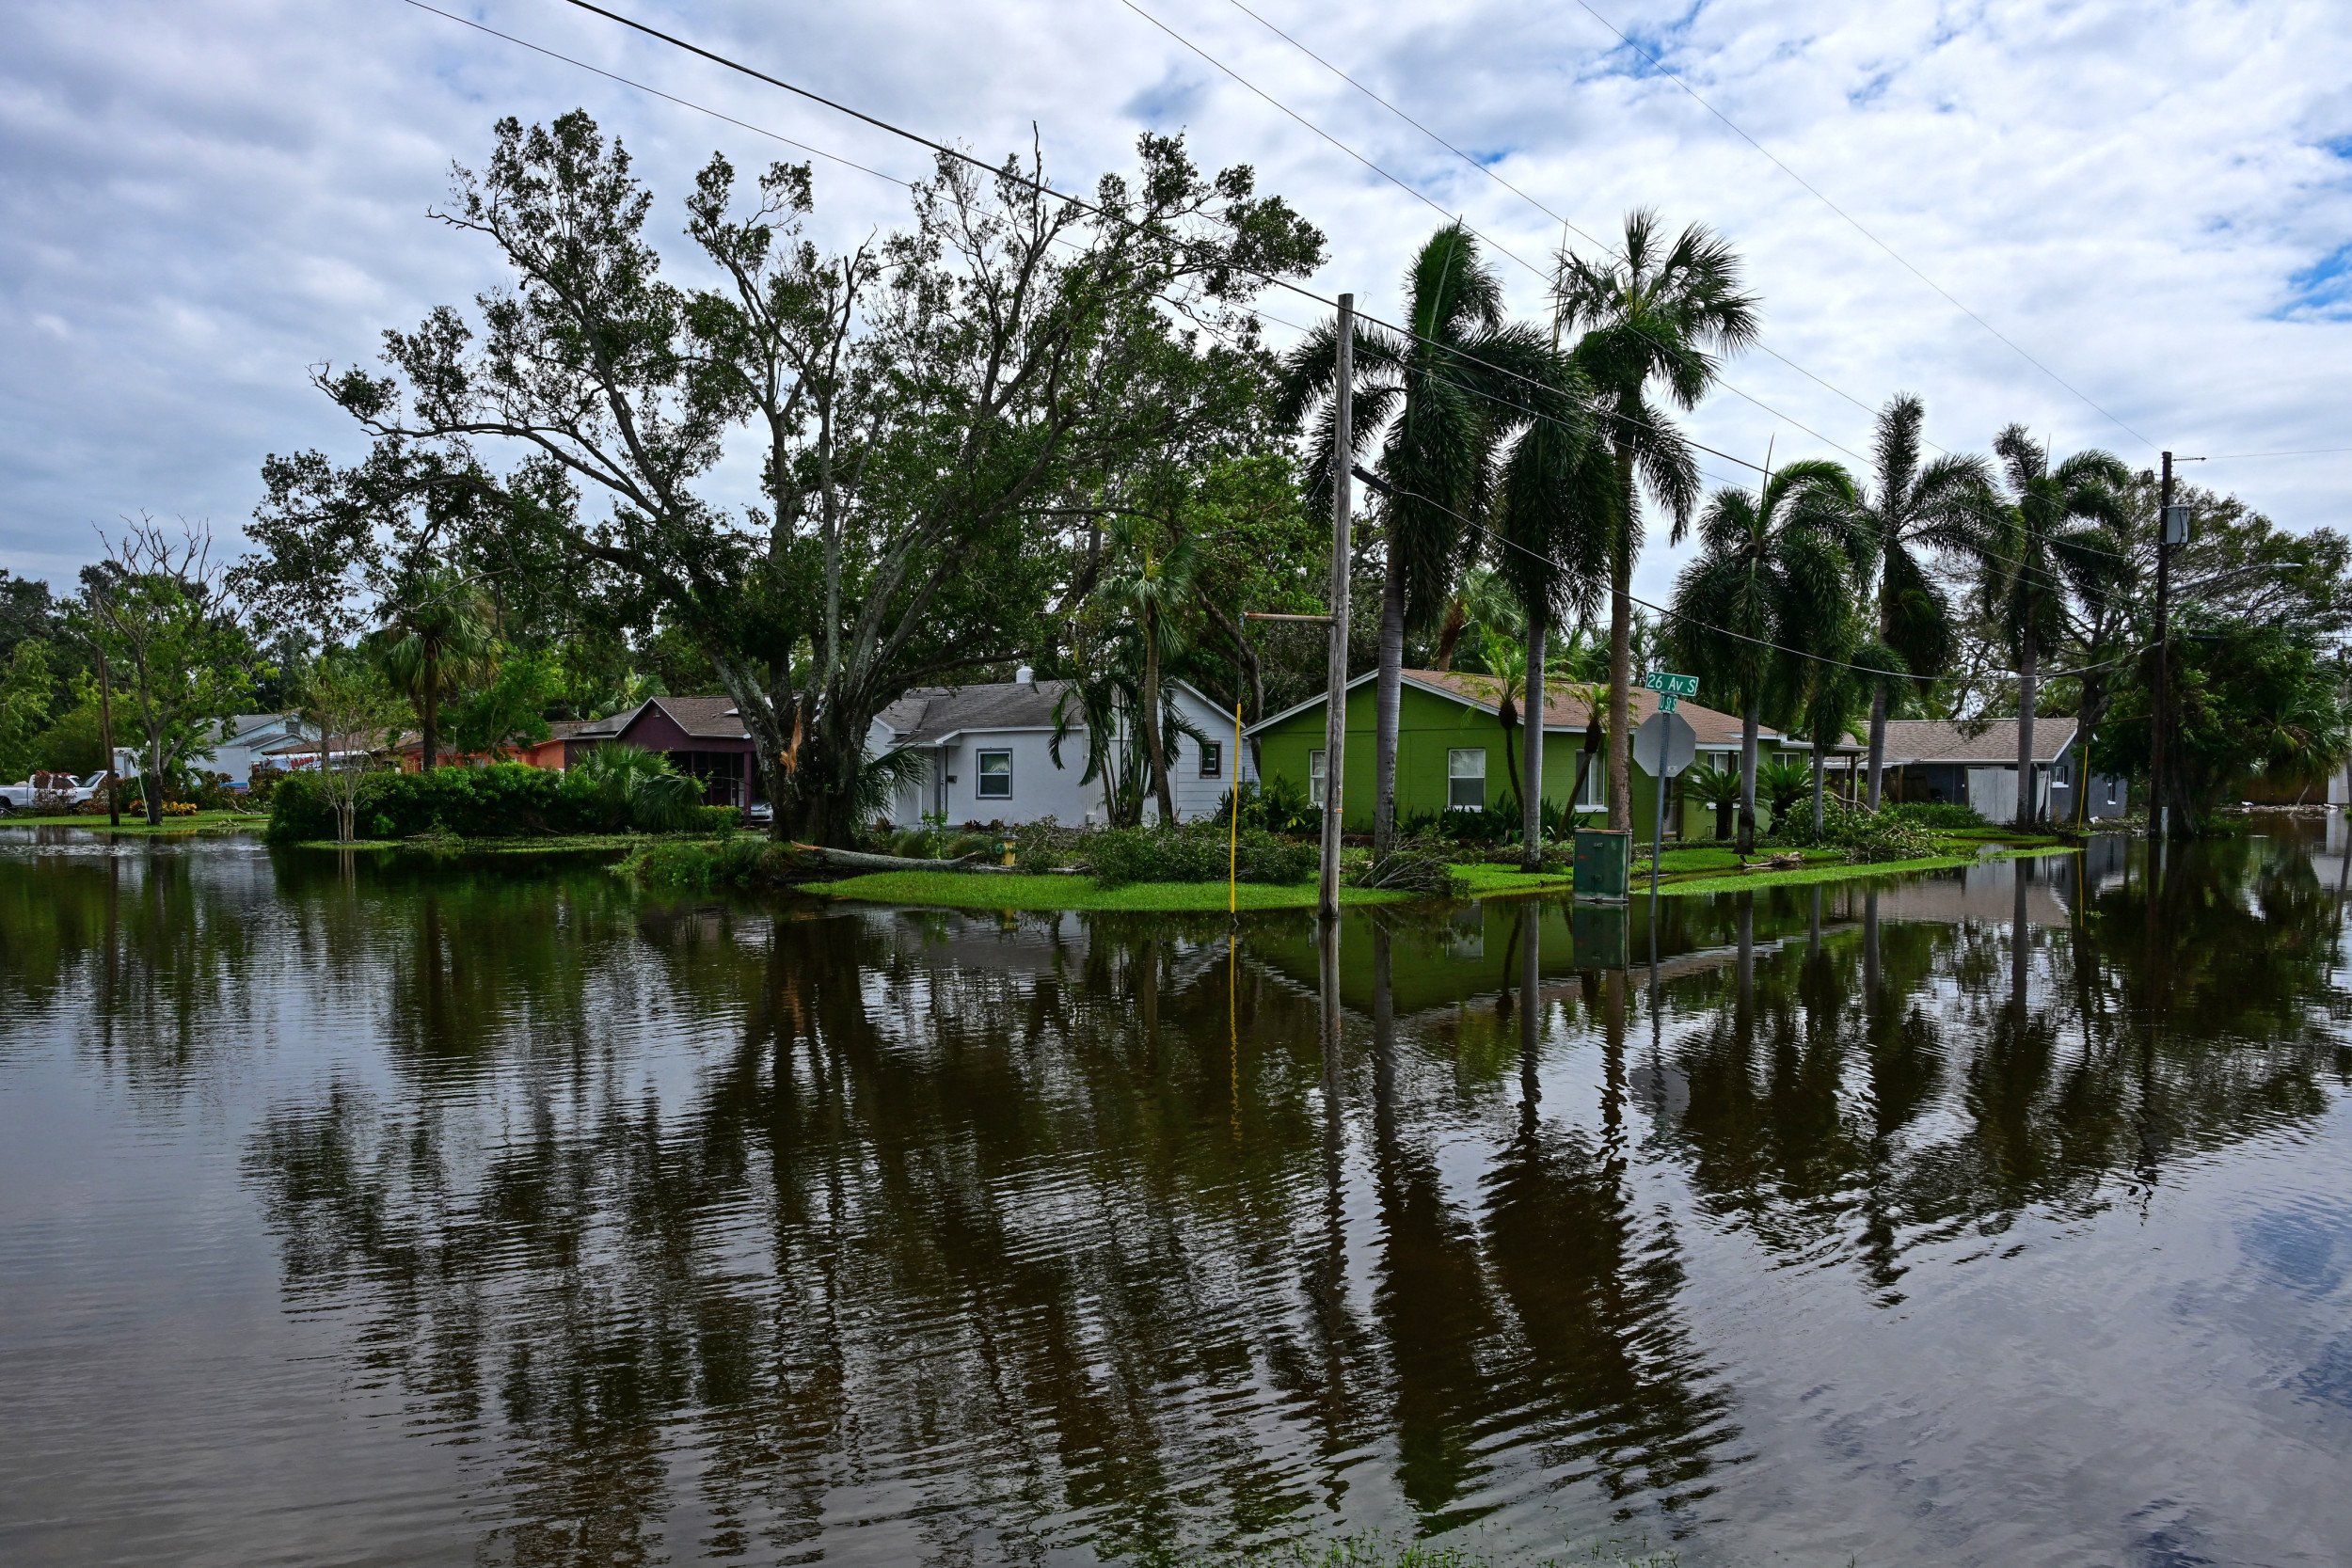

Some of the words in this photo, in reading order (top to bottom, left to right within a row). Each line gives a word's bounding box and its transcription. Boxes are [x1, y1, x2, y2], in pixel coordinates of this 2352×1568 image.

[1647, 674, 1662, 689] 26
[1668, 677, 1683, 690] Av
[1687, 679, 1695, 693] S
